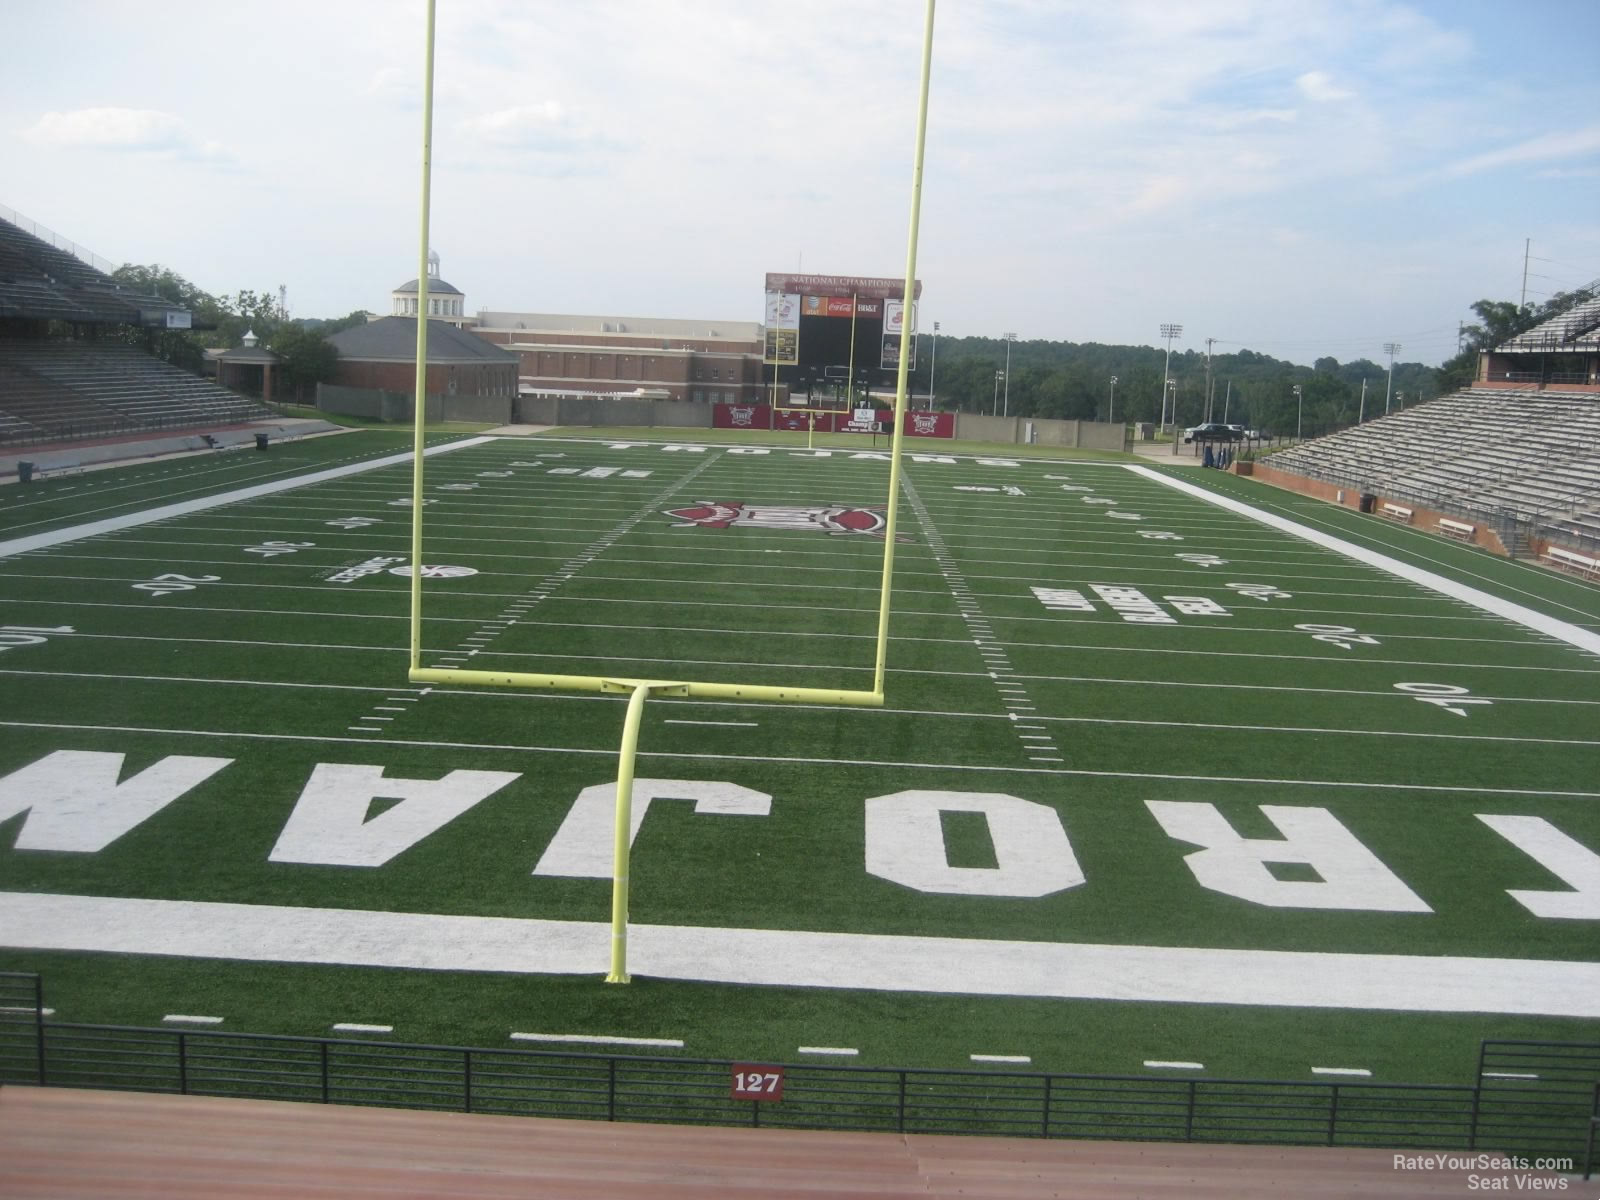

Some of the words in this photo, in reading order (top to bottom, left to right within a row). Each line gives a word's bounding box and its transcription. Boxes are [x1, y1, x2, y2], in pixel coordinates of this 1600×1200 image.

[792, 276, 836, 286] NATIONAL
[839, 278, 897, 288] CHAMPIONS
[857, 304, 878, 313] BB&T
[131, 573, 222, 592] 20
[1224, 582, 1293, 600] 30
[1293, 623, 1383, 646] 20
[1392, 681, 1494, 707] 10
[735, 1072, 779, 1093] 127
